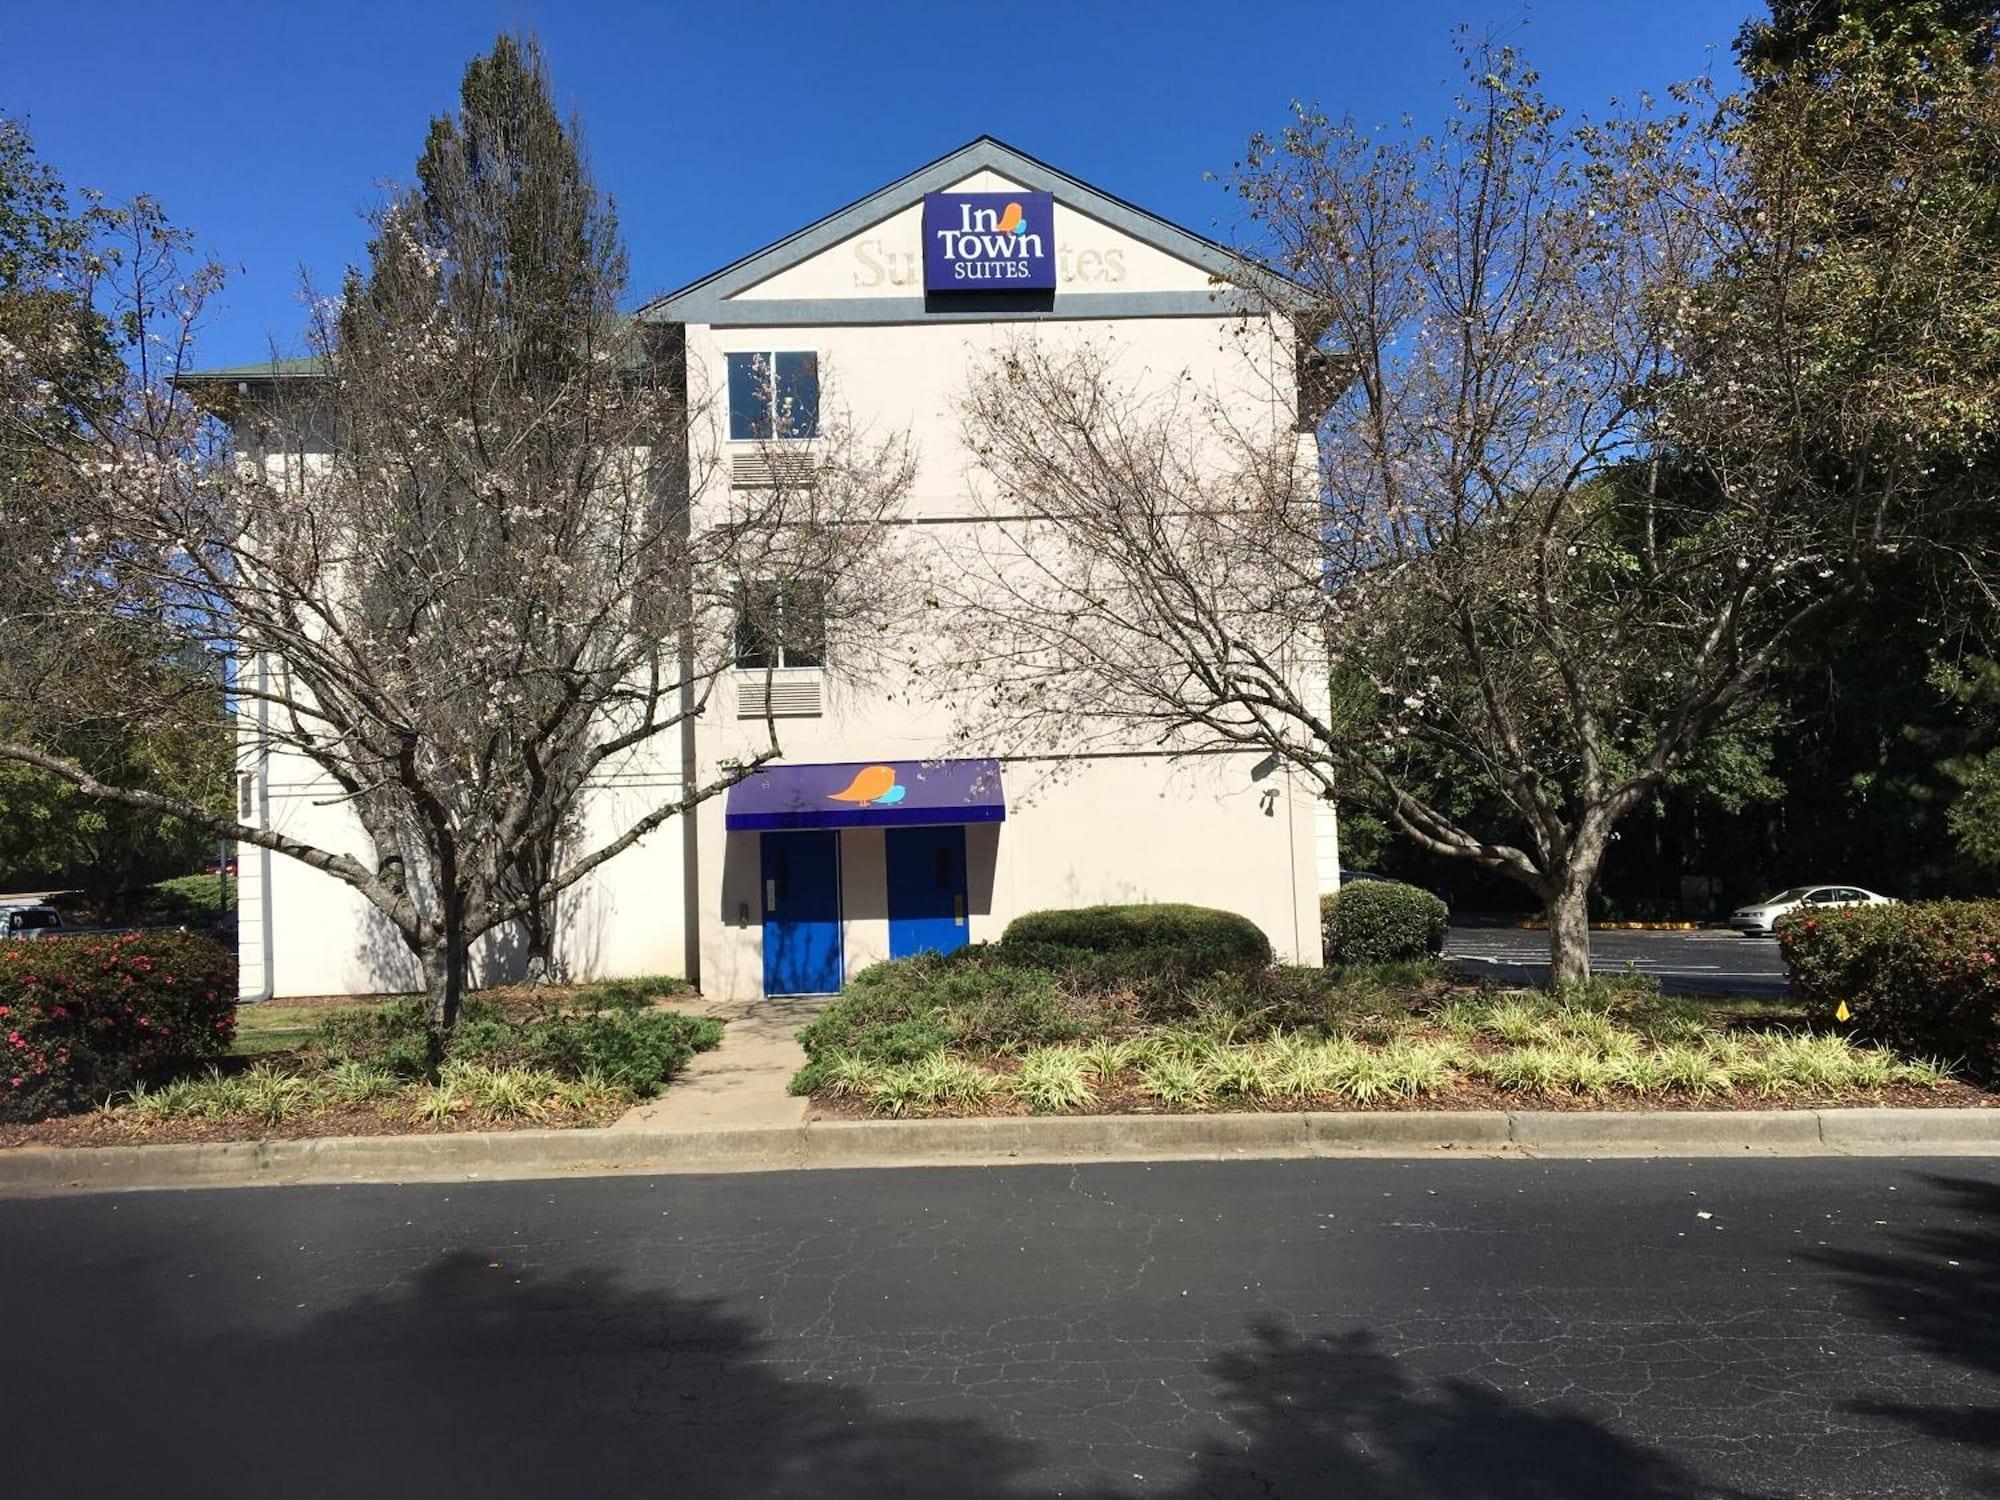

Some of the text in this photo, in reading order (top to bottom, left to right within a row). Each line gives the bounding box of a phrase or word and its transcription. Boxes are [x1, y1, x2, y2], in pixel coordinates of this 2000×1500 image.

[960, 203, 998, 233] In
[937, 230, 1044, 260] Town
[853, 239, 1127, 289] Su tes
